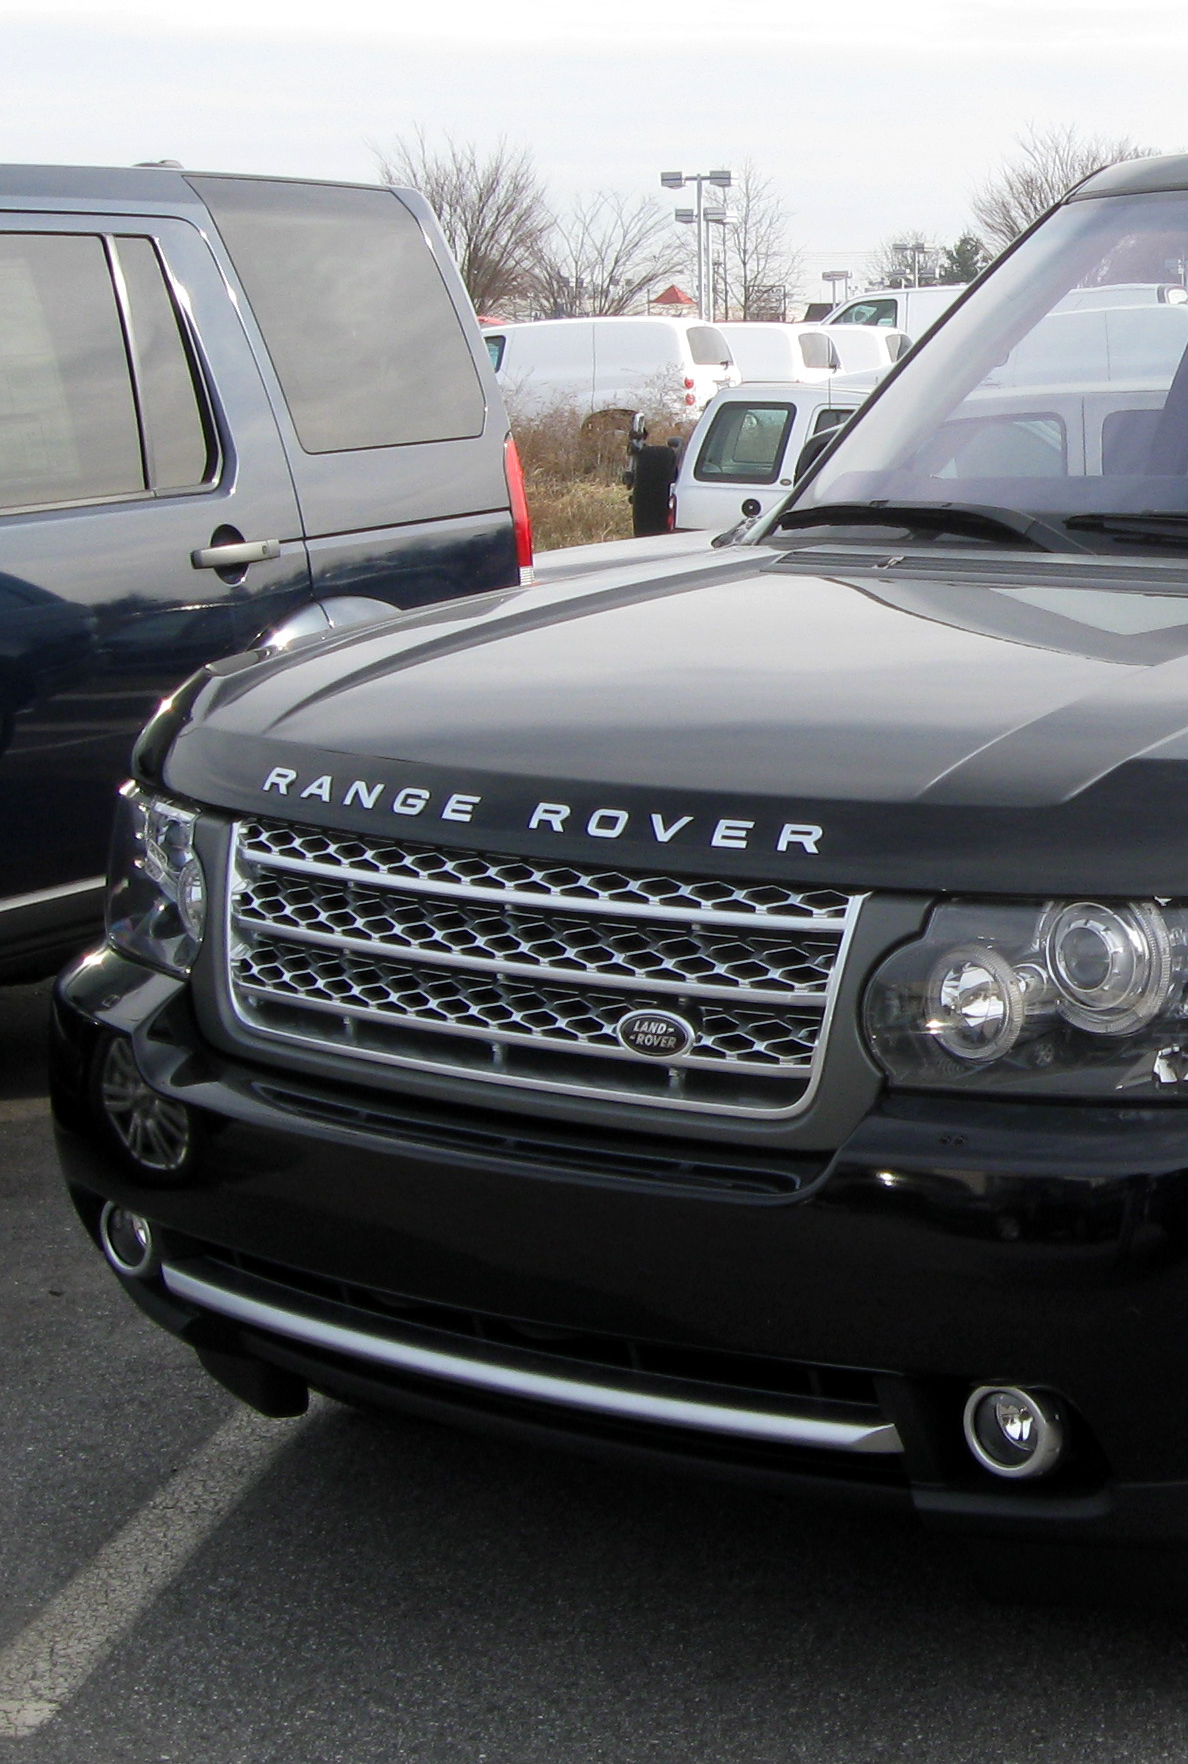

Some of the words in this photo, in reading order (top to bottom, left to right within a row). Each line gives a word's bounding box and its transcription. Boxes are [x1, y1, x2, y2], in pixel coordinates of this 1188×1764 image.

[262, 766, 482, 823] RANGE
[527, 801, 824, 855] ROVER
[633, 1020, 667, 1034] LAND
[635, 1034, 677, 1048] ROVER
